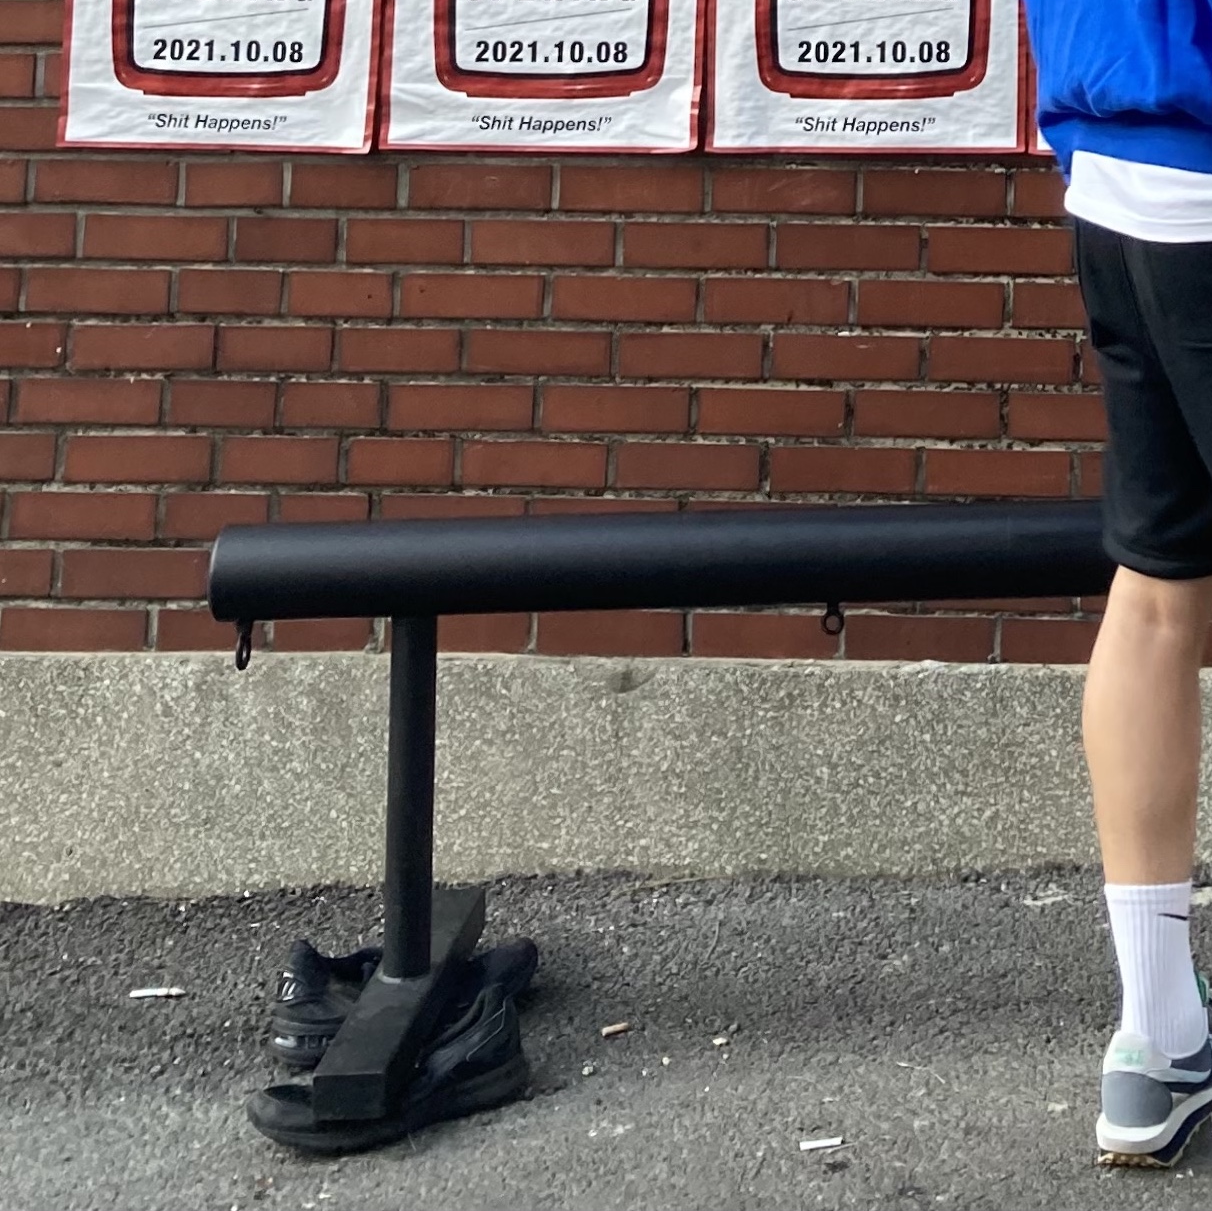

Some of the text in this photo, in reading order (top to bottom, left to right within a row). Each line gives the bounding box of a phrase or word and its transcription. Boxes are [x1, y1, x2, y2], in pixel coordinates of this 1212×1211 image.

[153, 39, 303, 62] 2021.10.08
[476, 41, 627, 62] 2021.10.08
[798, 41, 949, 63] 2021.10.08
[148, 114, 286, 132] “Shit Happens!”
[472, 116, 611, 133] “Shit Happens!”
[796, 117, 935, 135] “Shit Happens!”
